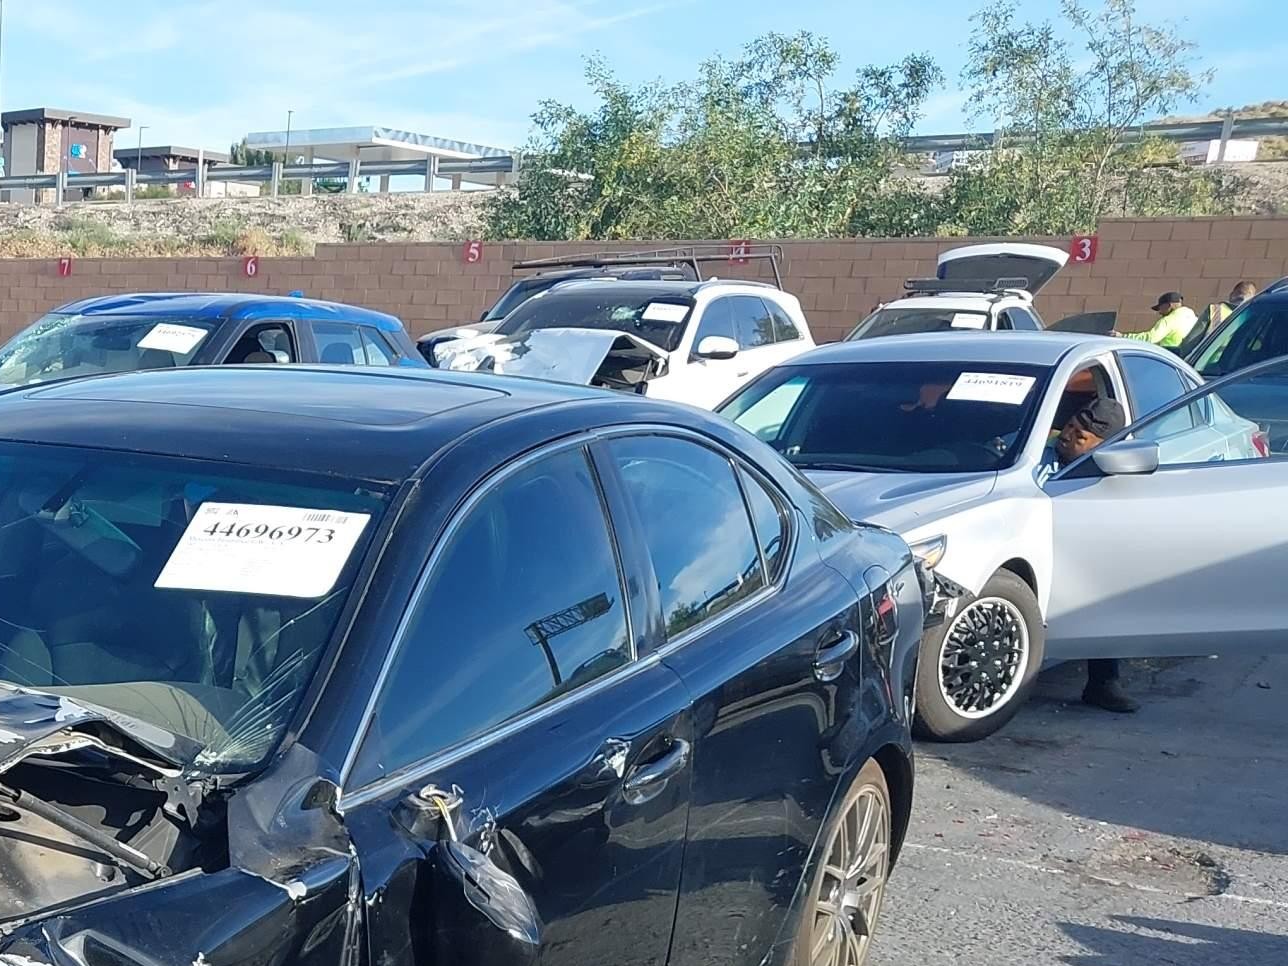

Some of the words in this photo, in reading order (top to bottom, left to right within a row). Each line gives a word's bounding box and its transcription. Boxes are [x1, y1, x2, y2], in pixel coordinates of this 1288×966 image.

[468, 243, 480, 262] 5
[1076, 238, 1091, 261] 3
[61, 258, 70, 275] 7
[246, 258, 256, 276] 6
[203, 521, 336, 544] 44696973
